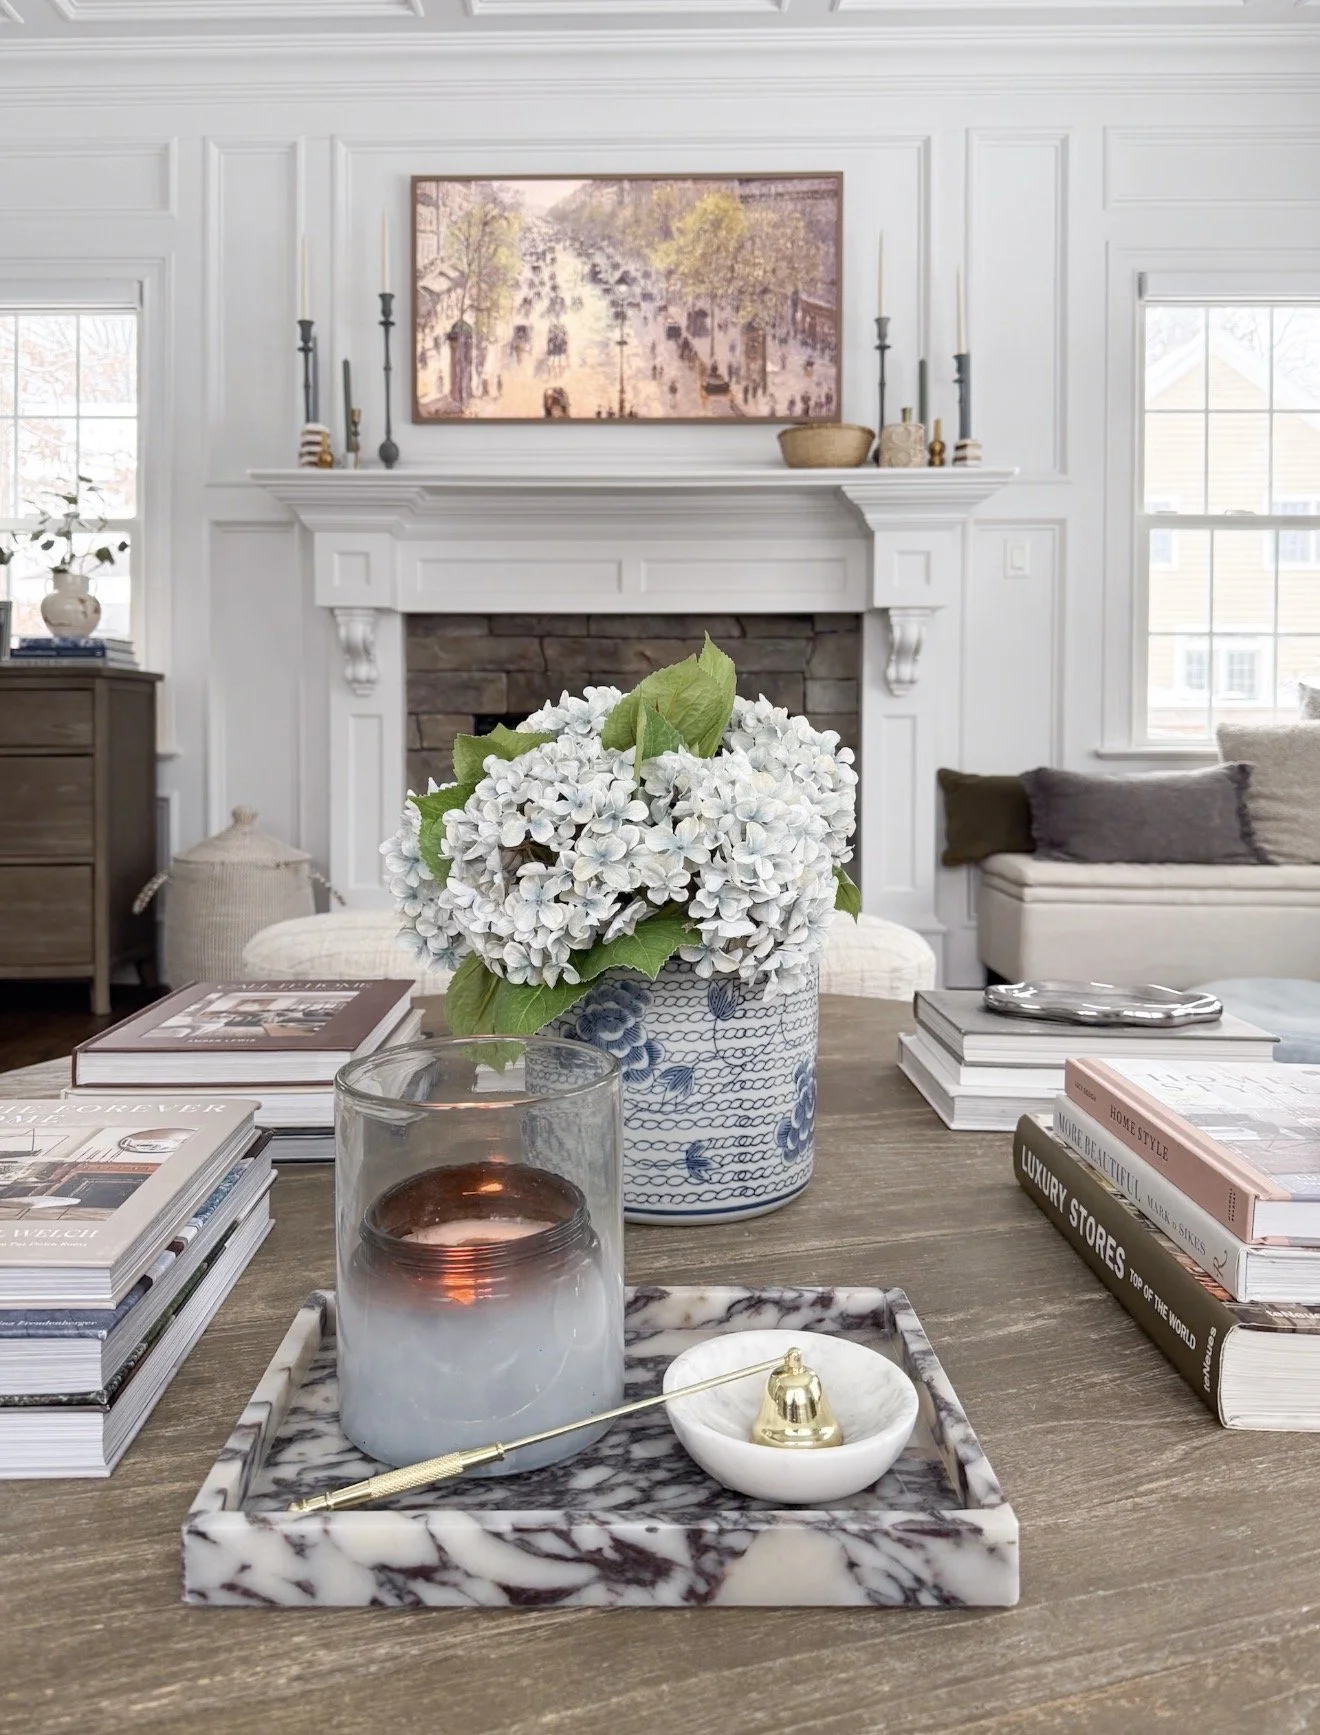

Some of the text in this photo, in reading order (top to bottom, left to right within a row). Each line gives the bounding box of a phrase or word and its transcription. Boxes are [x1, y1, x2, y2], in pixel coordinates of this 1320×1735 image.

[53, 1104, 227, 1113] FOREVER
[1110, 1105, 1169, 1161] HOME STYLE
[1059, 1113, 1141, 1202] MORE BEAUTIFUL
[14, 1229, 99, 1238] WELCH
[1021, 1145, 1126, 1279] LUXURY STORES
[1147, 1195, 1170, 1224] MARK
[1178, 1223, 1206, 1255] SIKES
[1129, 1268, 1196, 1350] TOP OF THE WORLD
[1203, 1326, 1217, 1393] teNeues
